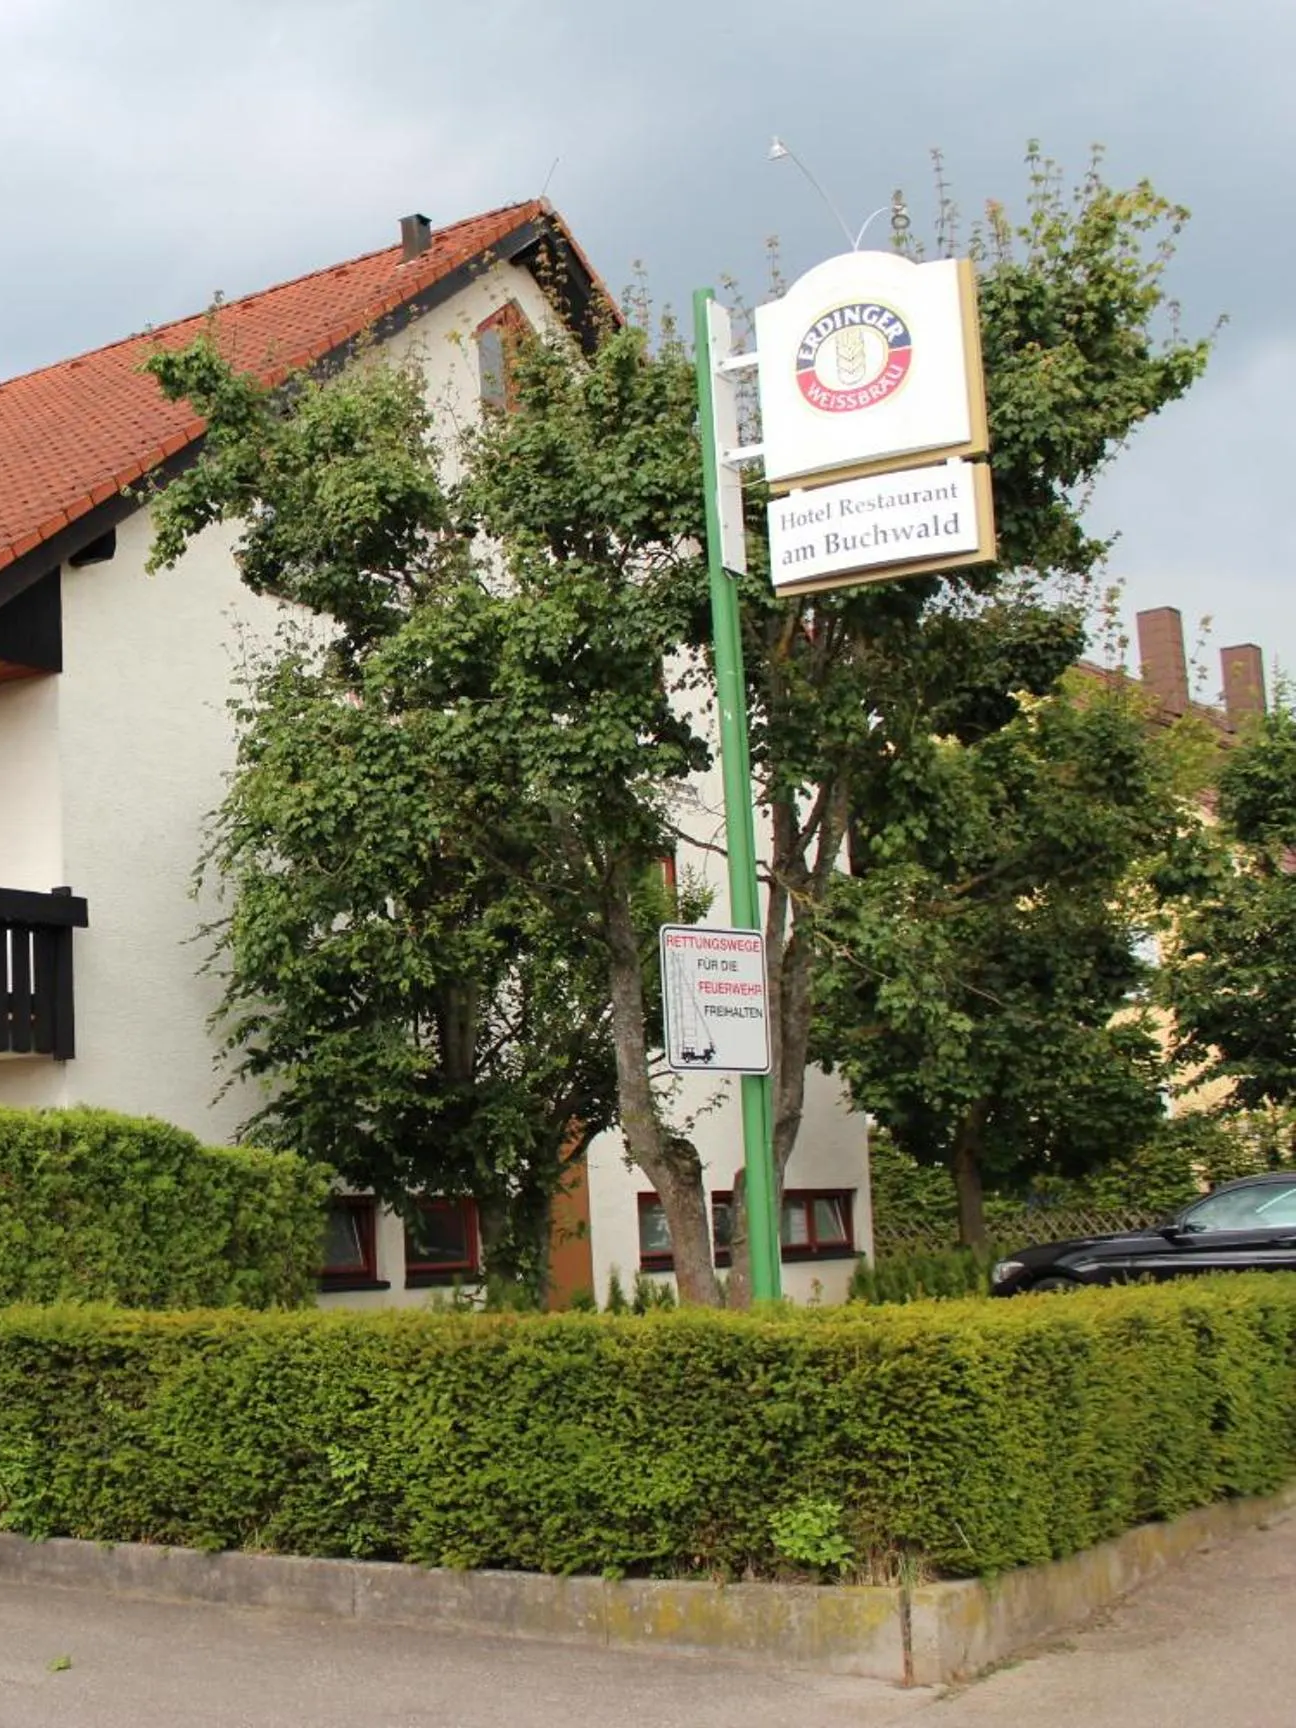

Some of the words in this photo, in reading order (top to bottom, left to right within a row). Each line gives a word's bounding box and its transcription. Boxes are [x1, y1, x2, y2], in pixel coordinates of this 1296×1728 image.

[798, 305, 904, 360] ERDINGER
[780, 502, 831, 532] Hotel
[839, 482, 959, 517] Restaurant
[782, 543, 816, 566] am
[824, 512, 960, 556] Buchwald
[666, 934, 761, 953] RETTUNGSWEGE
[697, 957, 718, 971] FÜR
[721, 960, 738, 972] DIE
[698, 981, 762, 996] FEUERWEHR
[704, 1005, 763, 1019] FREIHALTEN
